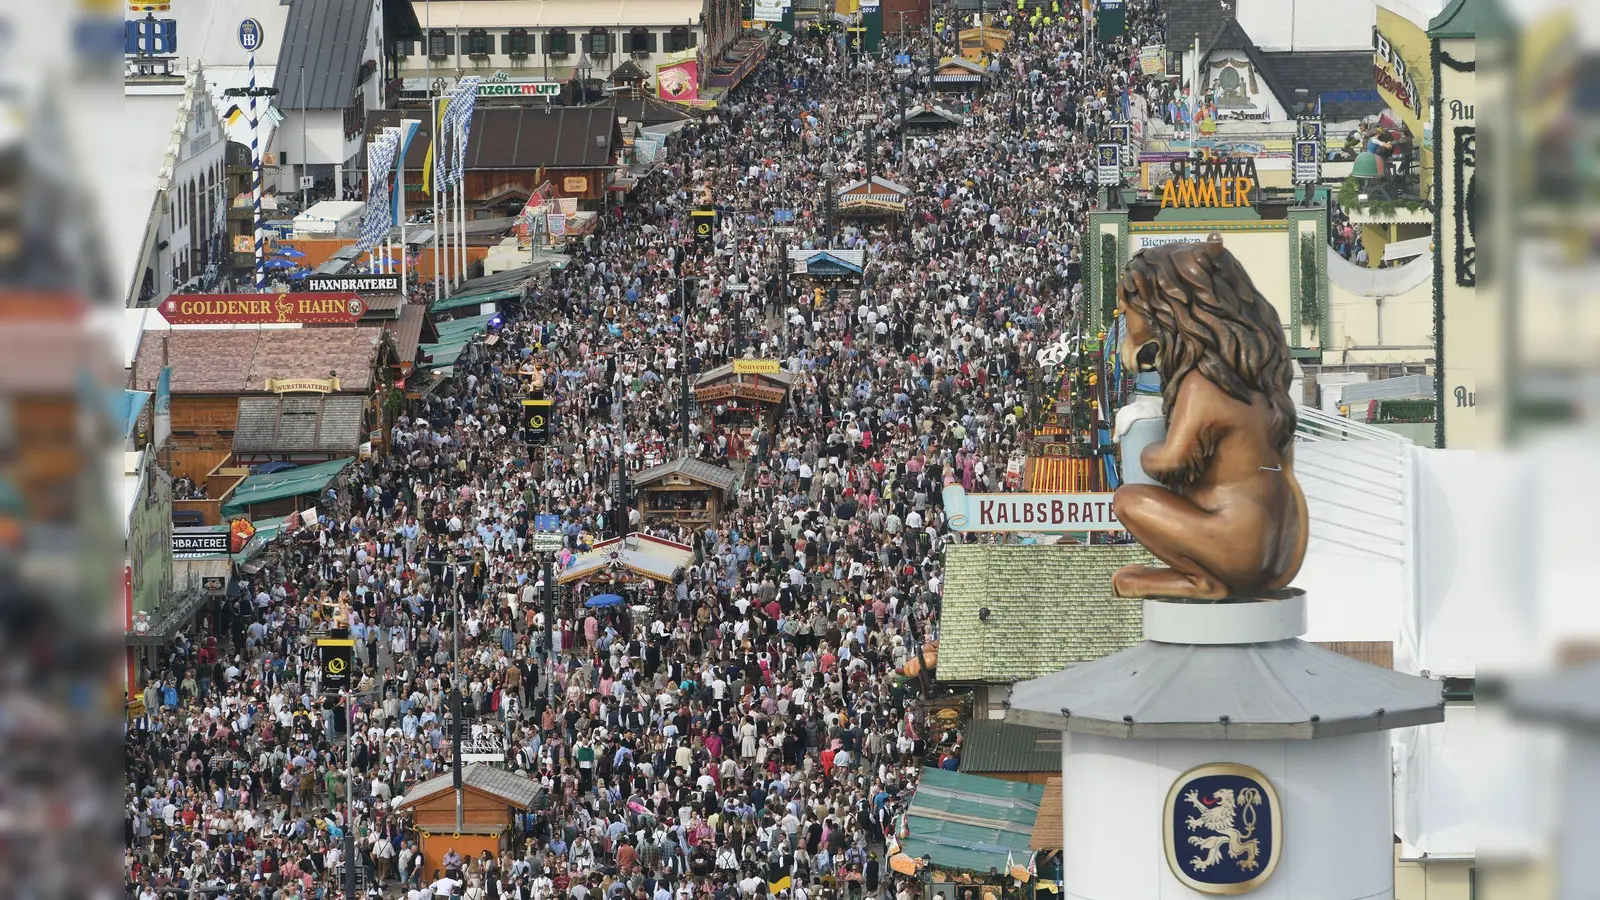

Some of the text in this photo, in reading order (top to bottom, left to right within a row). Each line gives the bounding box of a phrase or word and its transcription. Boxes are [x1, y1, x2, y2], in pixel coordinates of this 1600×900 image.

[243, 34, 255, 46] HB
[1160, 176, 1252, 209] AMMER
[309, 278, 397, 291] HAXNBRATEREI
[181, 299, 346, 315] GOLDENER HAHN
[738, 363, 775, 371] Souvenirs
[276, 383, 329, 391] WURSTBRATEREI
